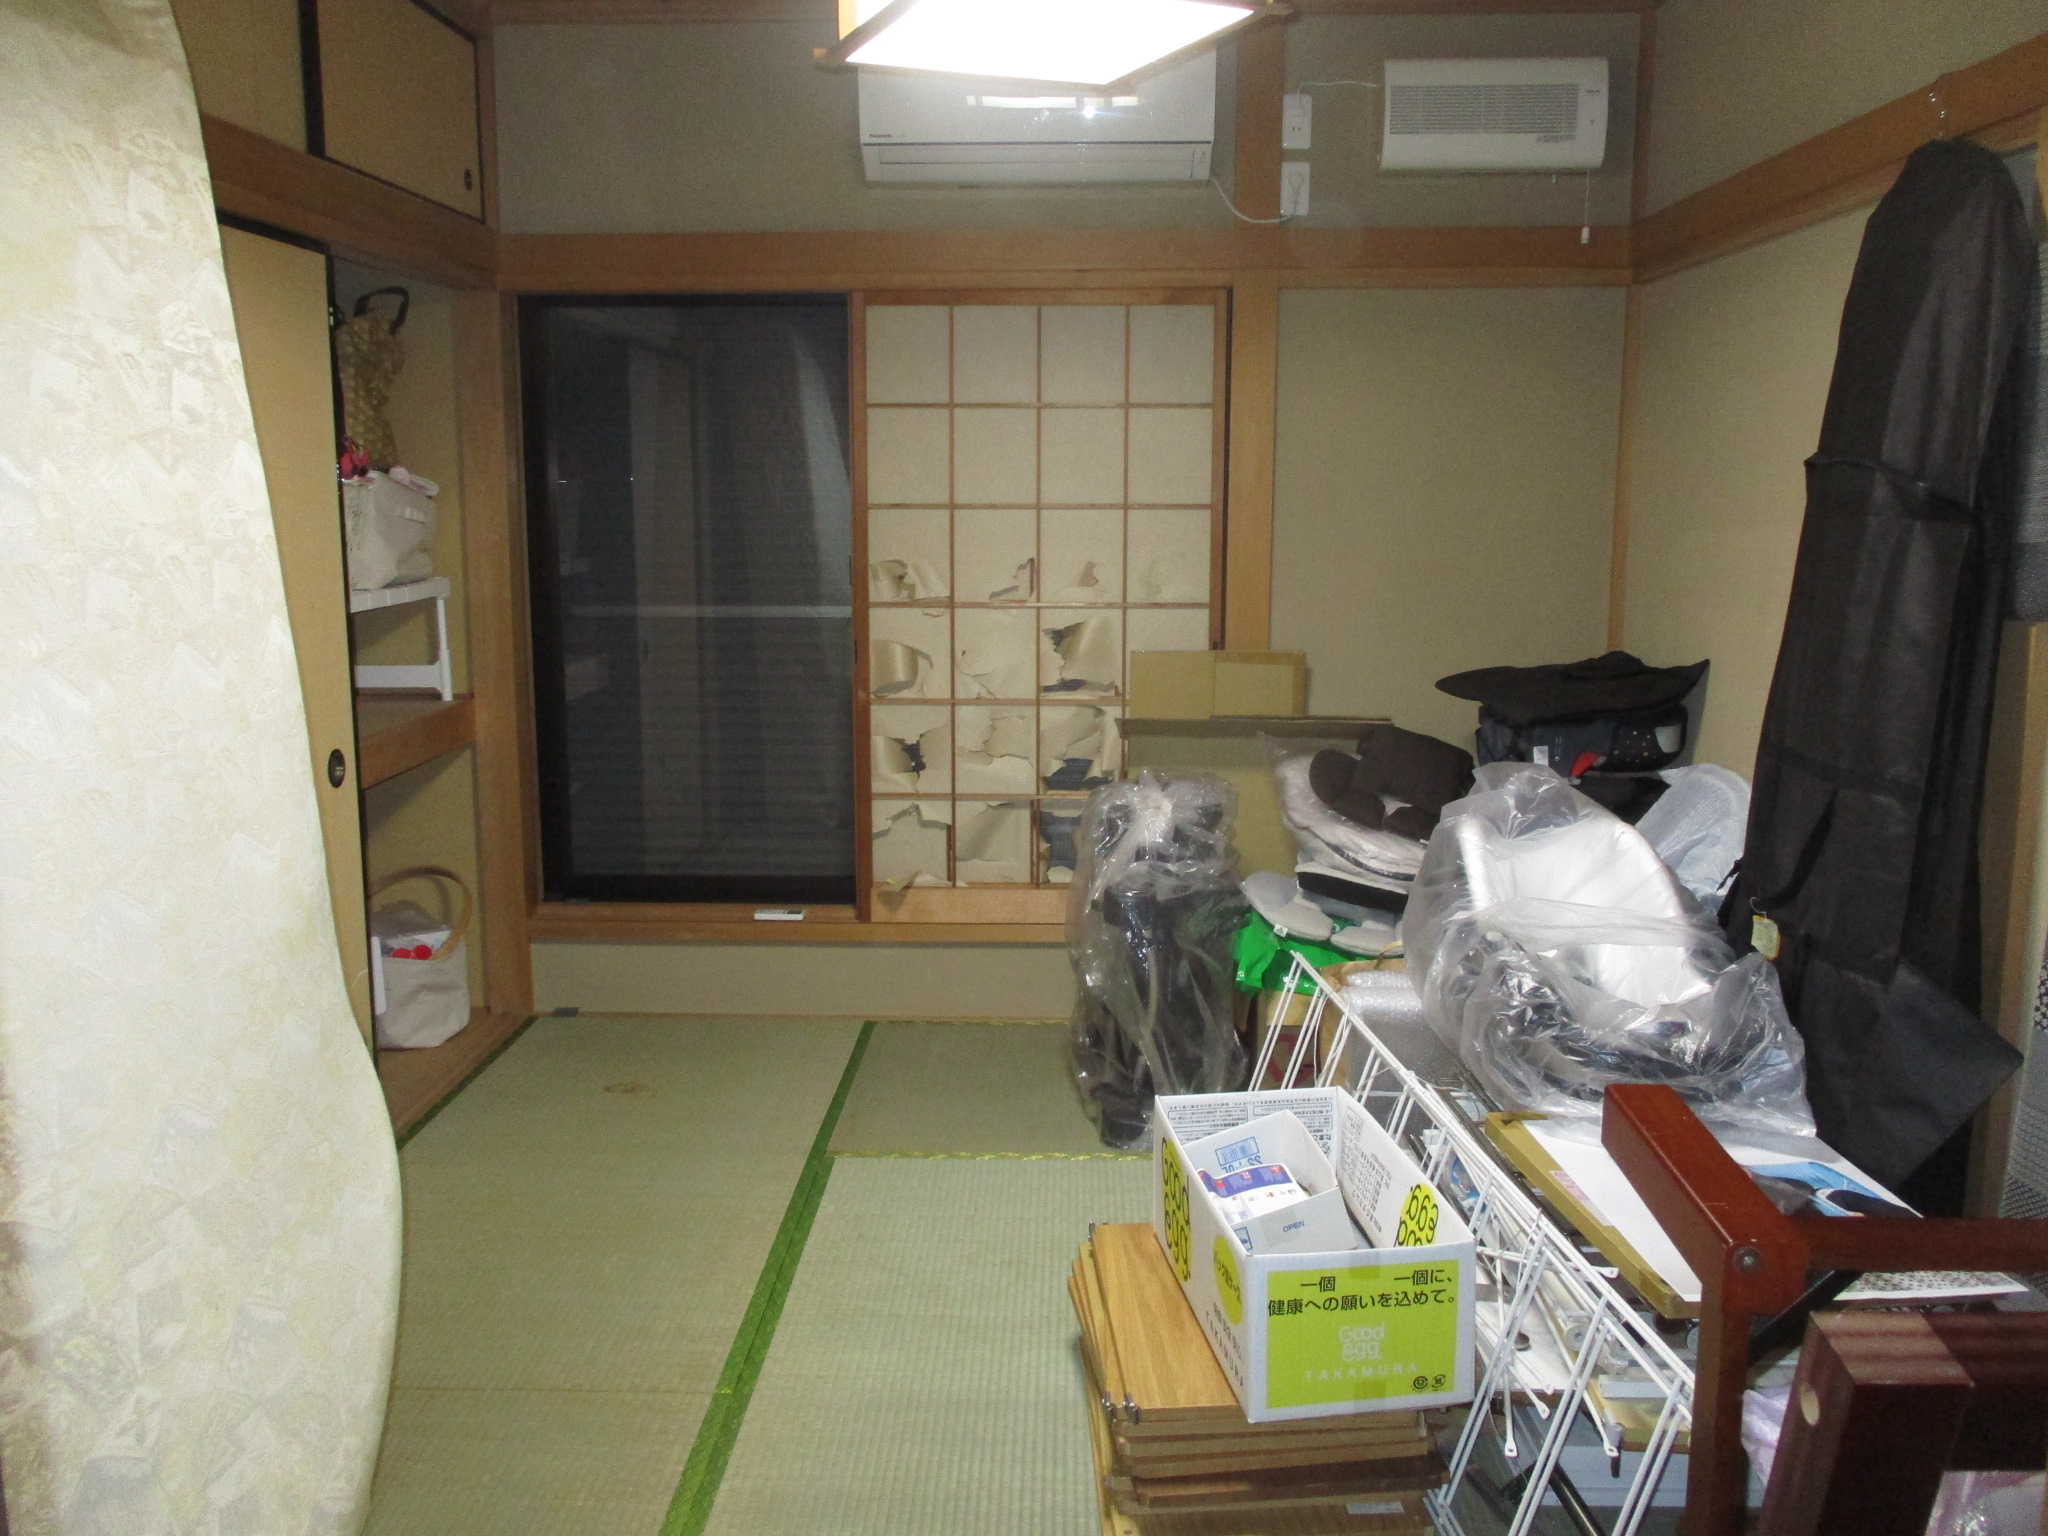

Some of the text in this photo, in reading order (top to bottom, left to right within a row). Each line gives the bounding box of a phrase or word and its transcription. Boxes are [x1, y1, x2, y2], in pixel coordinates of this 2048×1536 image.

[1282, 1220, 1305, 1233] OPEN
[1300, 1268, 1453, 1293] 一個 一個に、
[1267, 1288, 1456, 1317] 健康への願いを込めて。
[1305, 1362, 1418, 1381] TAKAMURA
